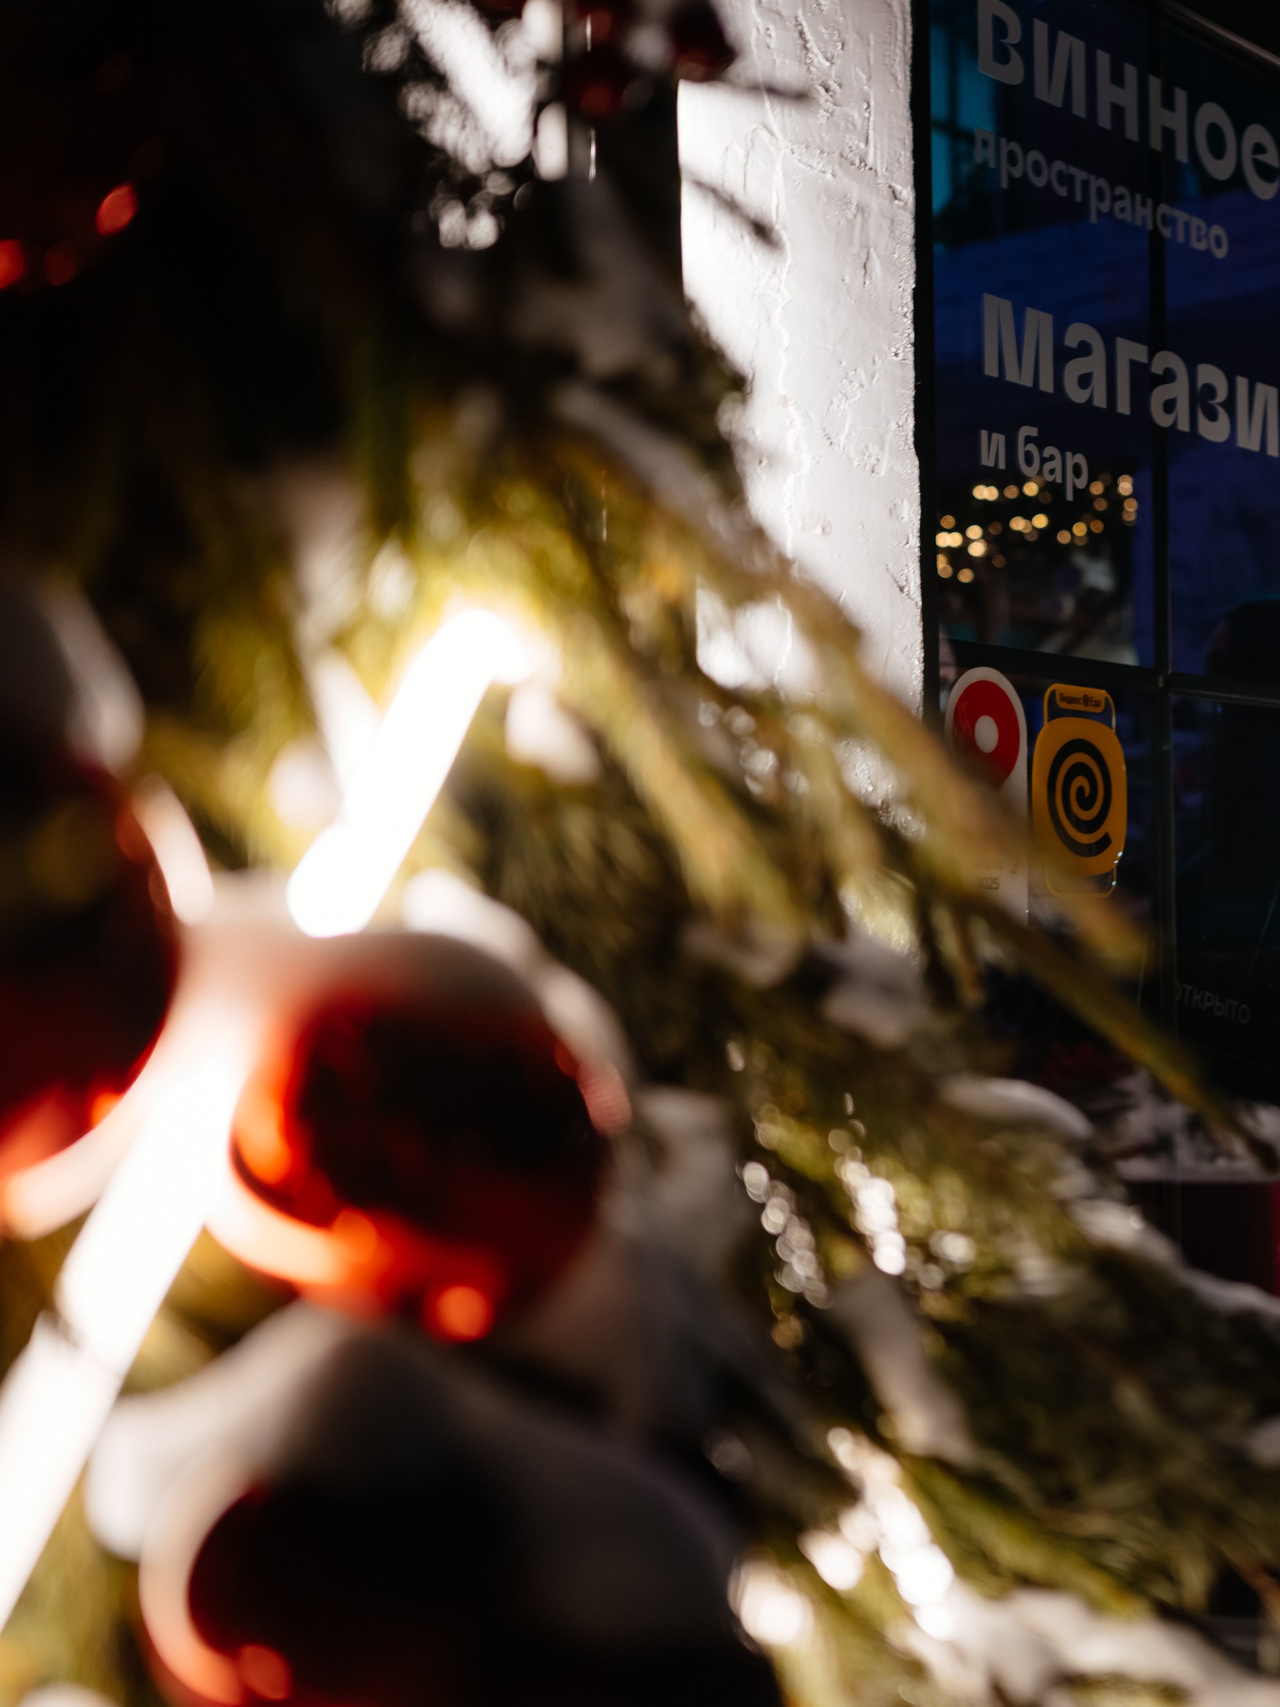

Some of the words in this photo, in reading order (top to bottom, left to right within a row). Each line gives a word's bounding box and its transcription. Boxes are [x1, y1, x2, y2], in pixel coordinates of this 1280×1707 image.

[977, 0, 1280, 200] винное
[974, 128, 1228, 259] пространство
[980, 429, 1006, 470] и
[1018, 425, 1089, 501] бар
